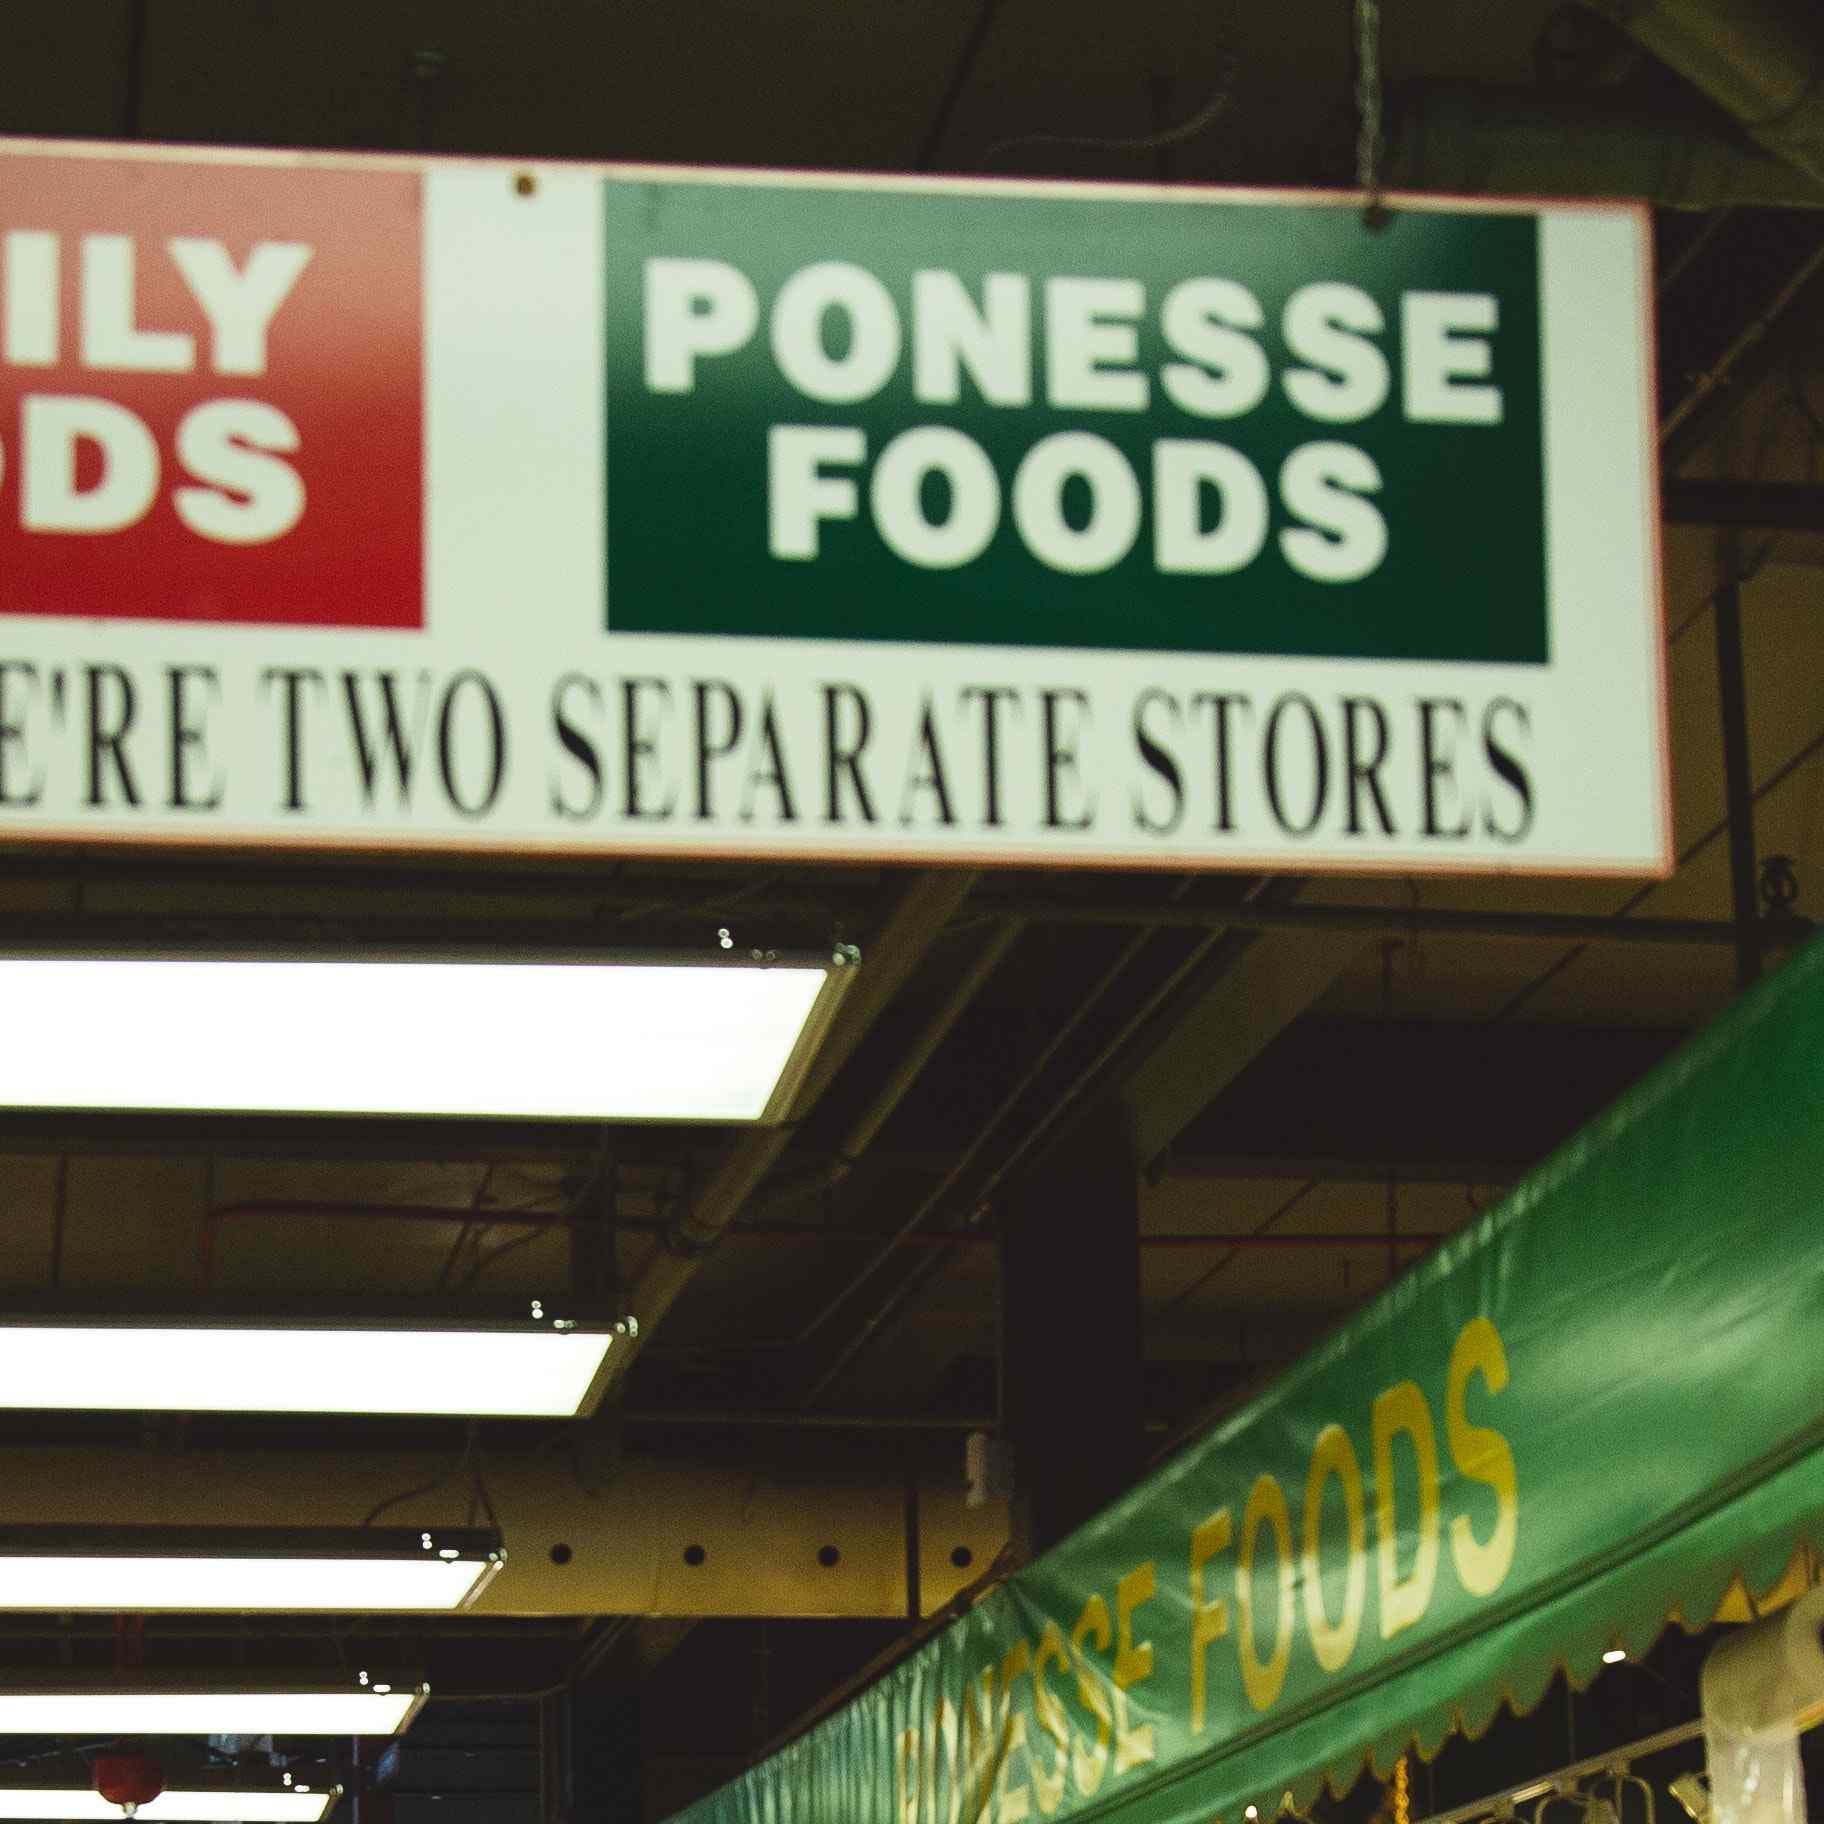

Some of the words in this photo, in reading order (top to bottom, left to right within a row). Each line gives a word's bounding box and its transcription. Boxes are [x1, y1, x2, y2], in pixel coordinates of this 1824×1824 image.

[641, 254, 1506, 428] PONESSE
[766, 423, 1392, 585] FOODS
[264, 665, 509, 822] TWO
[549, 669, 1095, 836] SEPARATE
[1129, 687, 1537, 846] STORES
[1188, 1316, 1517, 1737] FOODS
